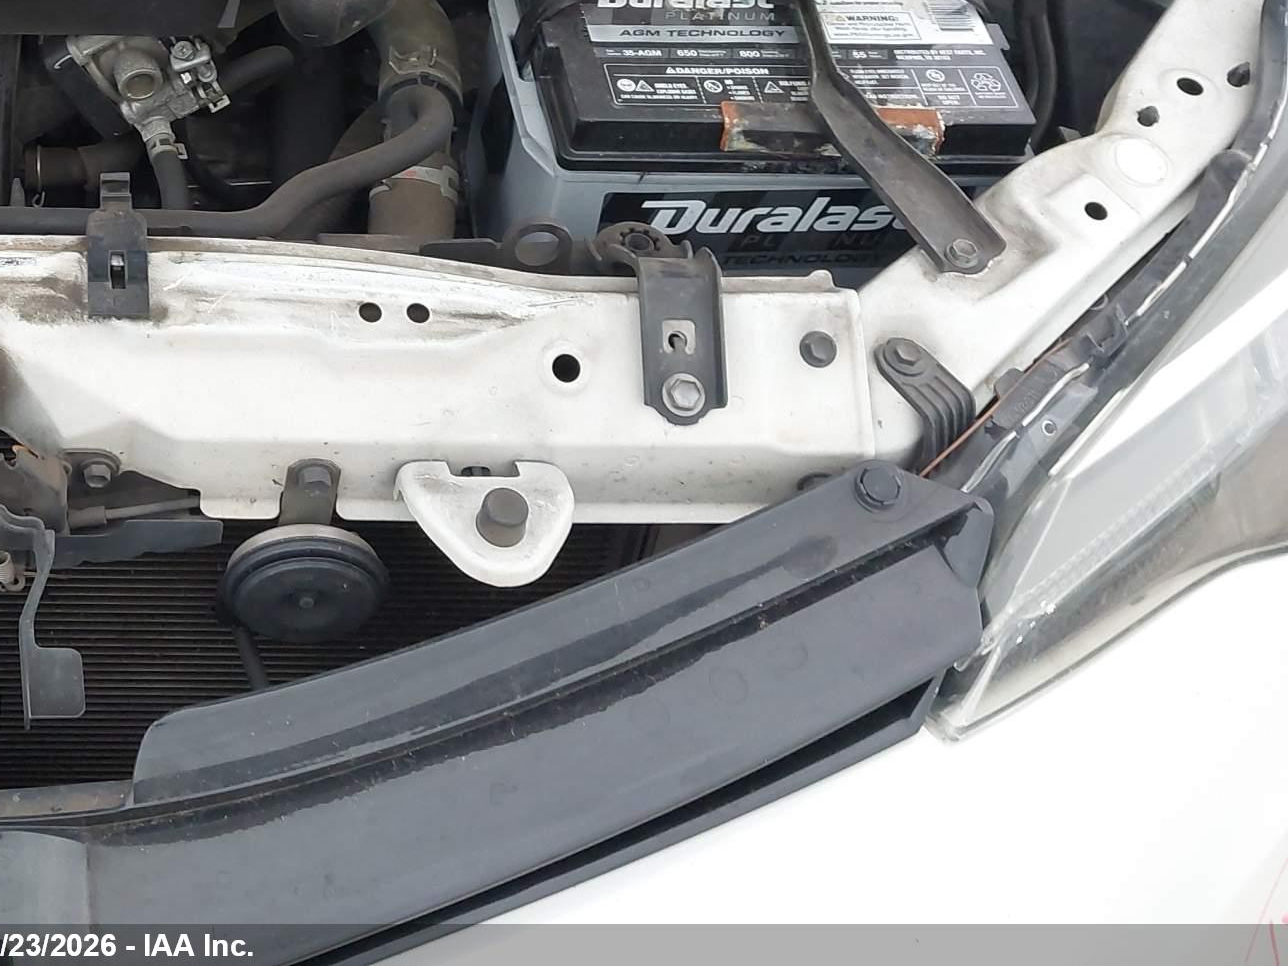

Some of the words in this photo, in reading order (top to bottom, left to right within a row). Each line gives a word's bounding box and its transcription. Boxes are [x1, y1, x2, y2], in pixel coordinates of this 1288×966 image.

[665, 12, 775, 22] PLATINUM
[619, 29, 660, 37] AGM
[669, 29, 785, 37] TECHNOLOGY
[676, 49, 698, 57] 650
[675, 66, 770, 75] DANGER/POISON
[641, 196, 909, 234] Duralas
